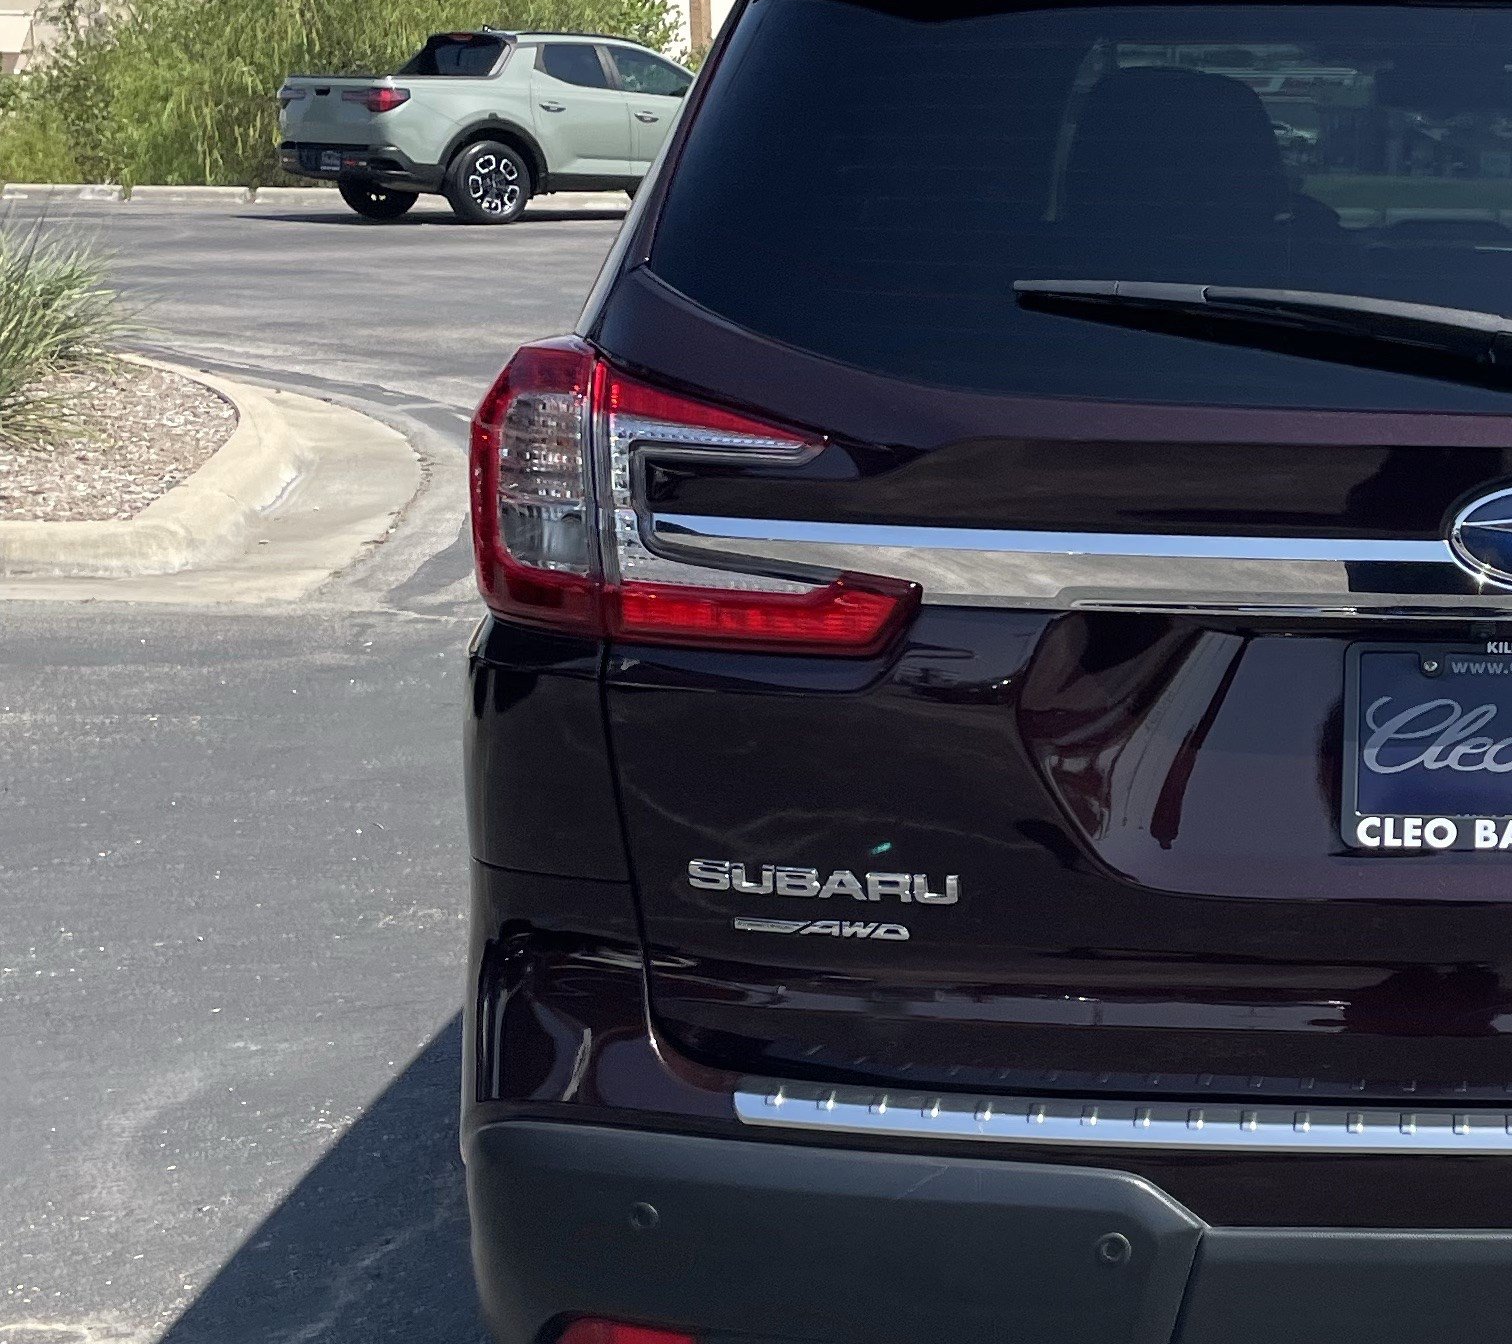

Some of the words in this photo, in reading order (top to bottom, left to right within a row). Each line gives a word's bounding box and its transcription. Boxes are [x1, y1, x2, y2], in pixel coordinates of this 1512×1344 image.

[1356, 816, 1458, 849] CLEO
[687, 858, 961, 906] SUBARU
[797, 919, 911, 941] AWD
